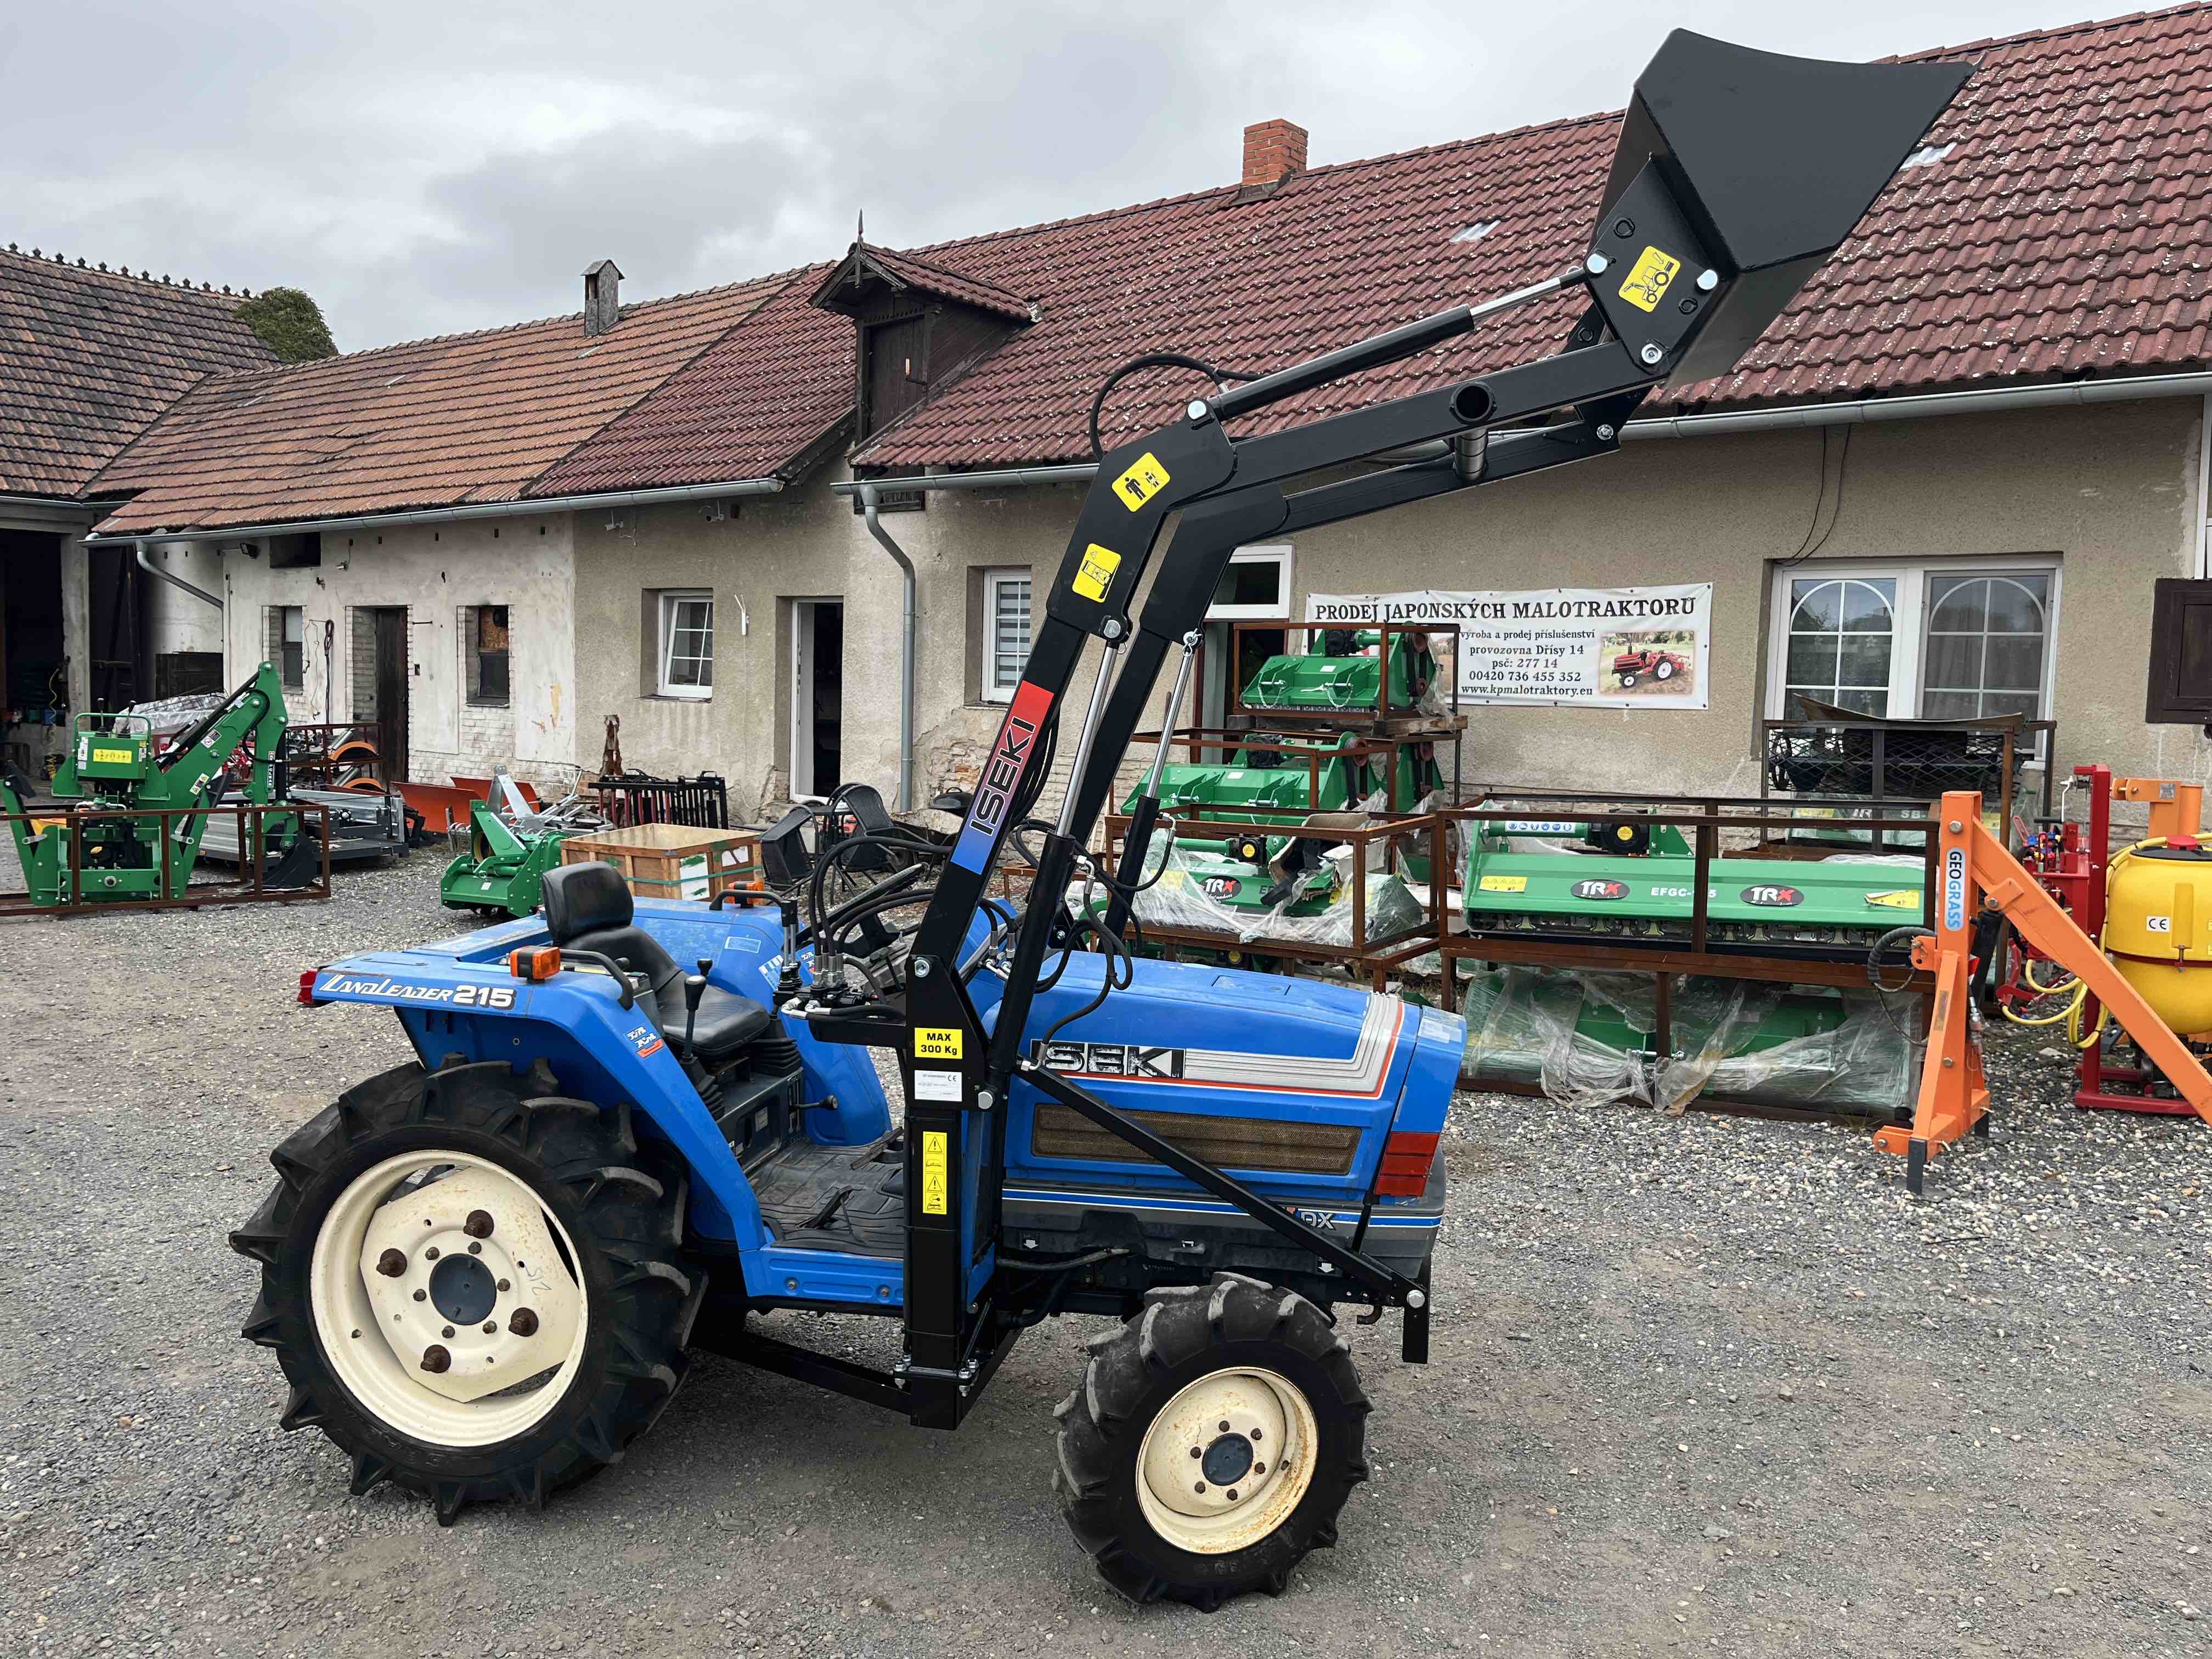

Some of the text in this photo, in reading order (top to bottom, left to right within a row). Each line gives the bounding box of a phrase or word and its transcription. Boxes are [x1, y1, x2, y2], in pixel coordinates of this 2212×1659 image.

[1315, 597, 1696, 623] PRODEJ JAPONSKÝCH MALOTRAKTORŮ
[1460, 629, 1492, 640] výroba
[1503, 630, 1532, 640] prodej
[1534, 629, 1595, 640] příslušenství
[1470, 645, 1584, 657] provozovna Dřísy 14
[1517, 658, 1539, 668] 277
[1544, 658, 1558, 668] 14
[1469, 671, 1581, 682] 00420 736 455 352
[1461, 685, 1593, 697] www.kpmalotraktory.eu
[969, 715, 1036, 837] ISEKI
[1948, 851, 1962, 928] GEOGRASS
[2148, 918, 2167, 930] CE
[452, 985, 516, 1009] 215
[927, 1032, 951, 1041] MAX
[921, 1045, 957, 1056] 300 Kg
